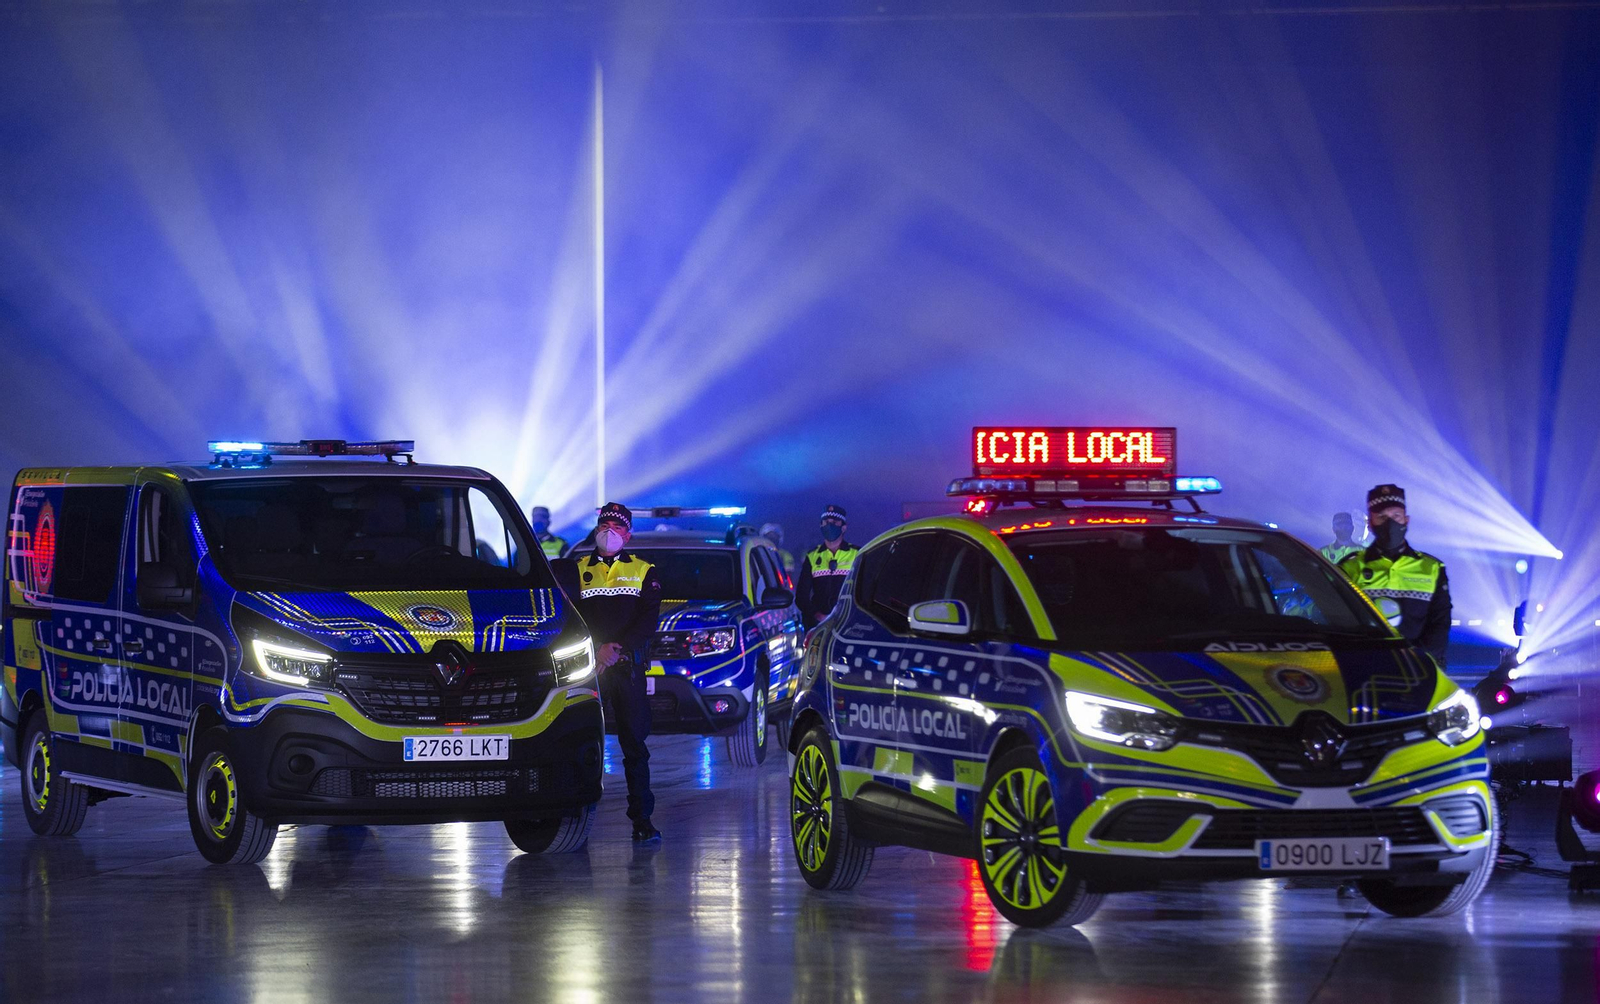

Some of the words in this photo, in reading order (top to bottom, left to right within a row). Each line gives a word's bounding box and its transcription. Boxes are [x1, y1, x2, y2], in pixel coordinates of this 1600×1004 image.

[1067, 432, 1166, 463] LOCAL
[136, 677, 191, 718] LOCAL
[849, 699, 910, 733] POLICÍA
[912, 708, 967, 740] LOCAL
[417, 739, 463, 757] 2766
[470, 739, 503, 756] LKT
[1276, 844, 1333, 866] 0900
[1342, 844, 1383, 866] LJZ
